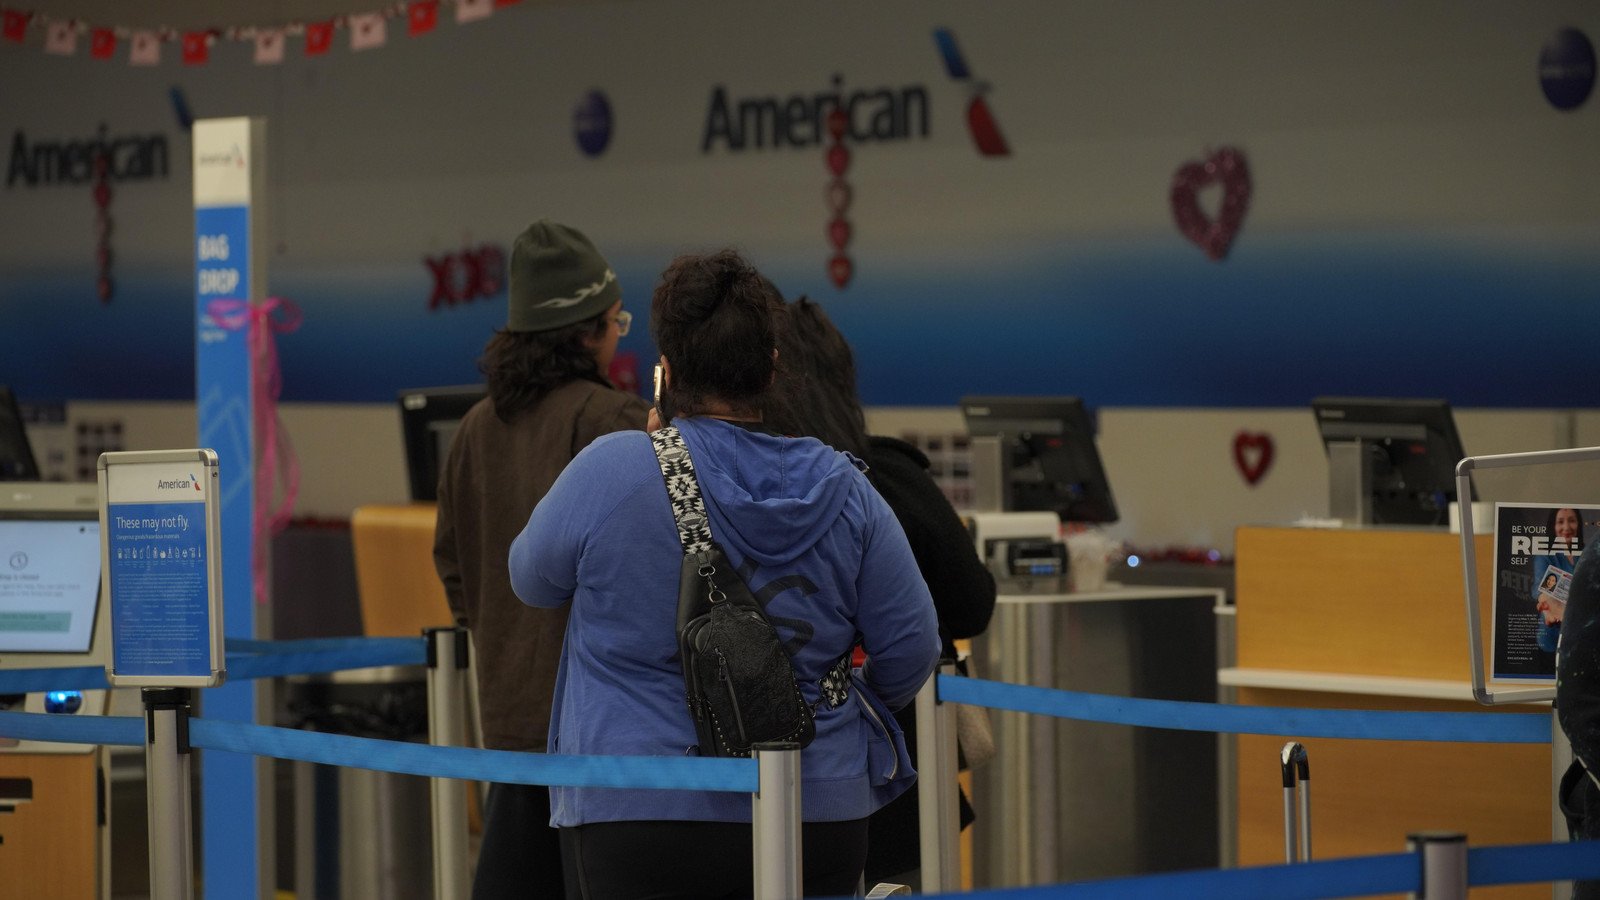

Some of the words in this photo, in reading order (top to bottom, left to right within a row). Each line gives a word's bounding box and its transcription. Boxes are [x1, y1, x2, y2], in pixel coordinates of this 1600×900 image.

[198, 233, 230, 262] BAG
[198, 267, 240, 295] DROP
[158, 479, 190, 490] American
[116, 516, 140, 529] These
[142, 518, 160, 532] may
[161, 516, 176, 528] not
[177, 514, 190, 531] fly.
[1512, 525, 1521, 534] BE
[1523, 525, 1547, 534] YOUR
[1512, 536, 1583, 556] REAL
[1510, 557, 1529, 565] SELF
